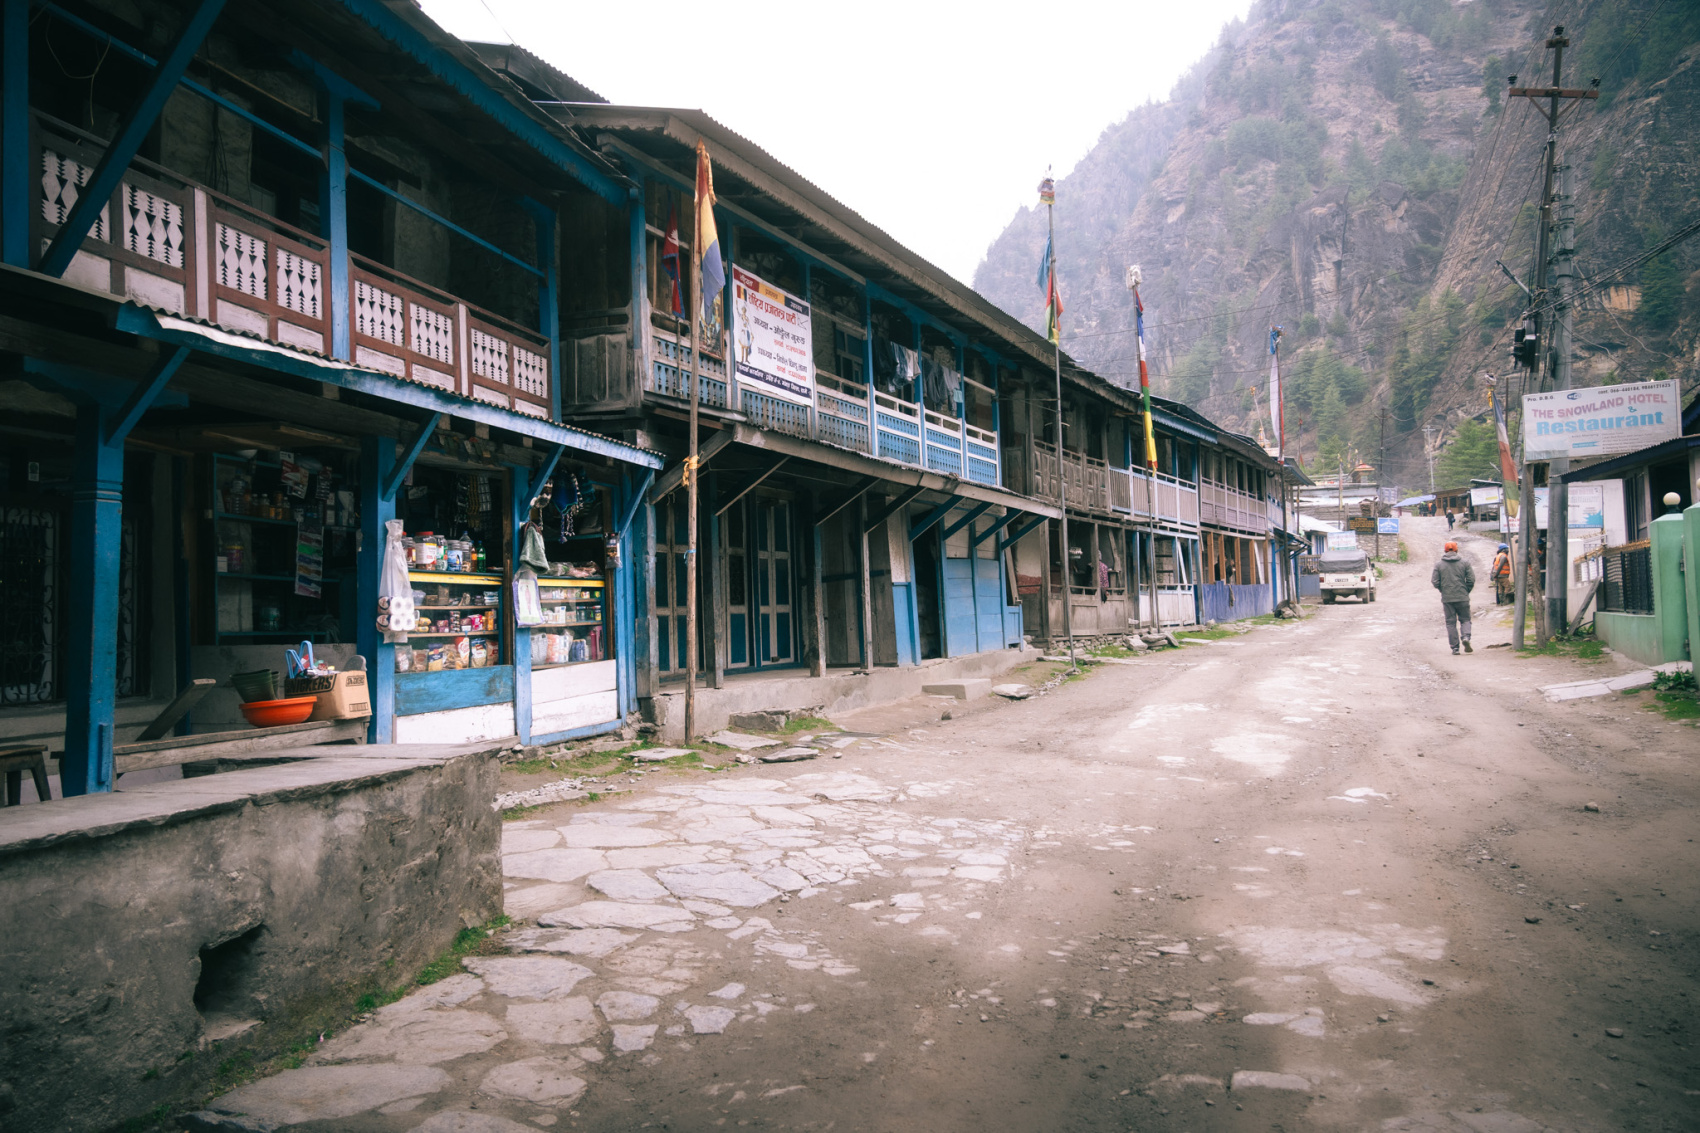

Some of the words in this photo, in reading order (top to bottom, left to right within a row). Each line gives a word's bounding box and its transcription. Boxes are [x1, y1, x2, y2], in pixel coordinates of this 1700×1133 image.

[1531, 408, 1554, 419] THE
[1557, 397, 1625, 419] SNOWLAND
[1628, 393, 1668, 405] HOTEL
[1627, 405, 1638, 413] &
[1536, 411, 1664, 436] Restaurant
